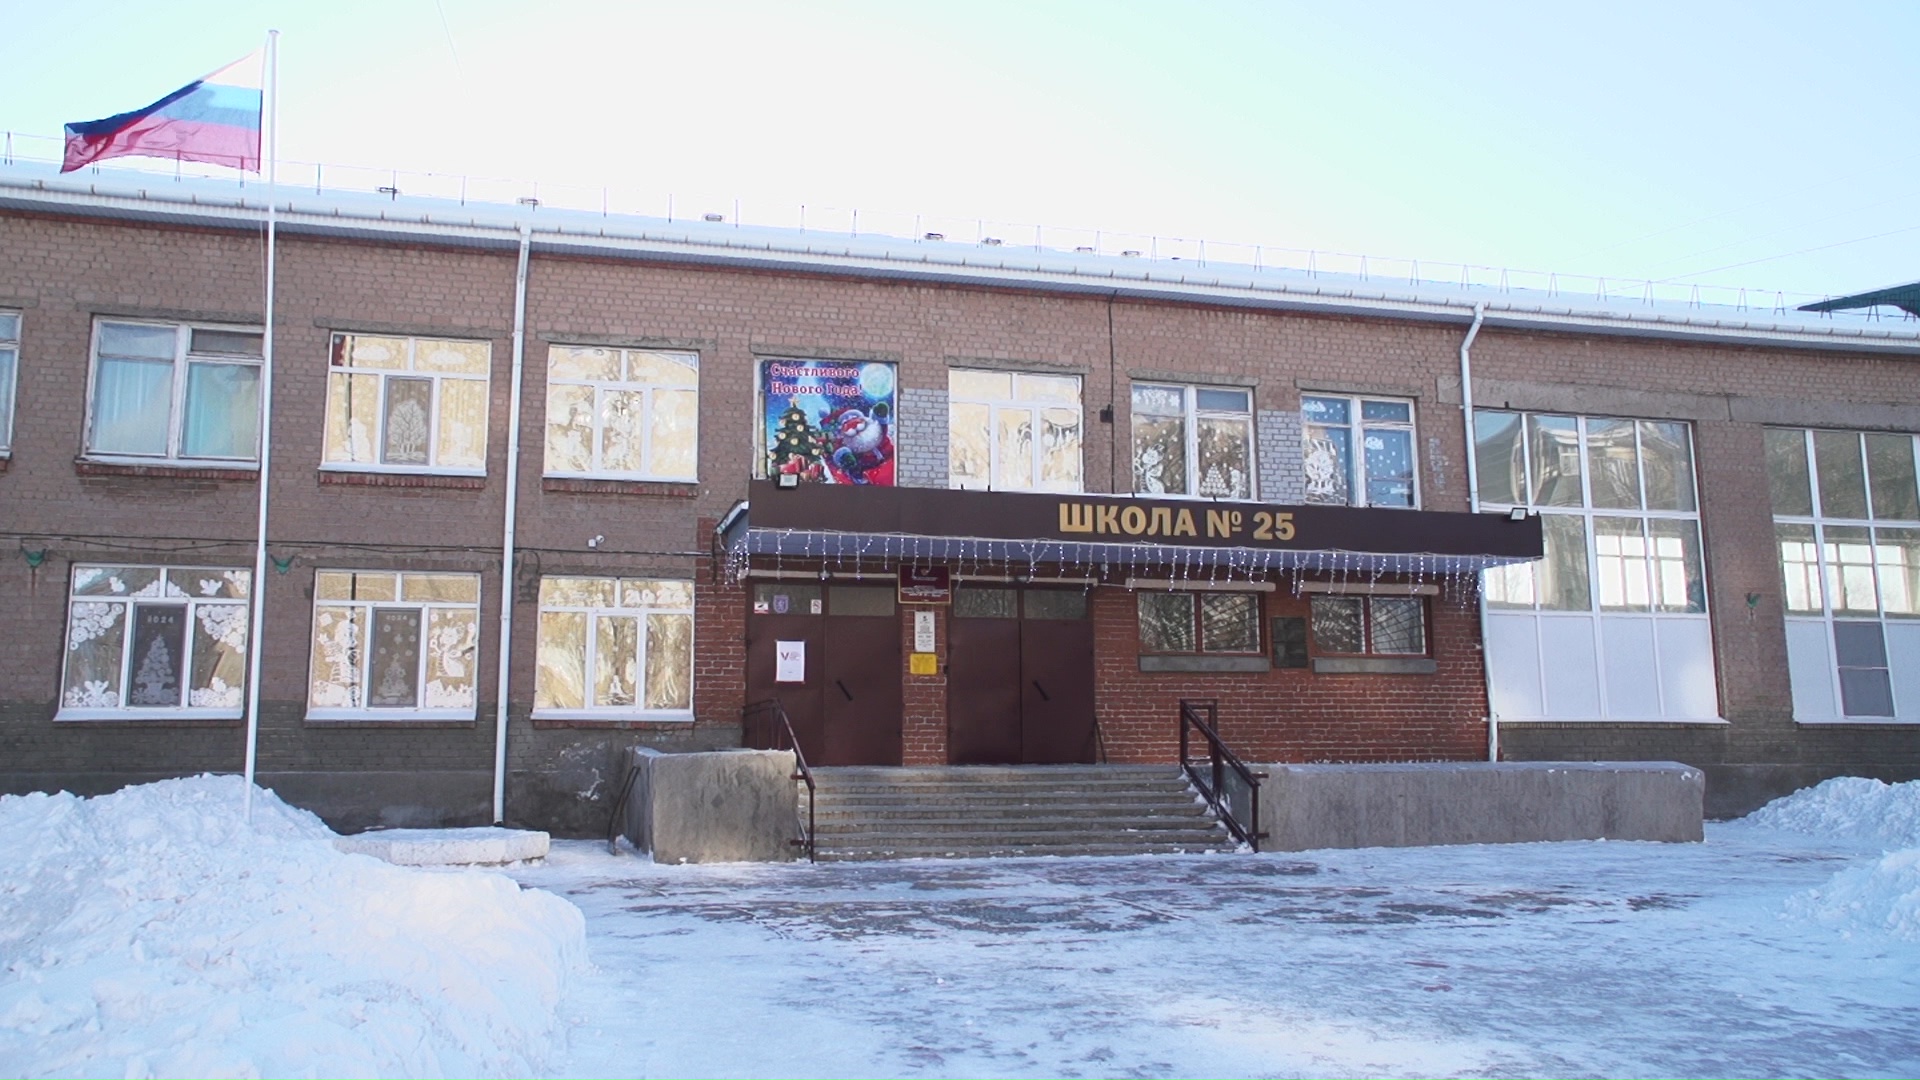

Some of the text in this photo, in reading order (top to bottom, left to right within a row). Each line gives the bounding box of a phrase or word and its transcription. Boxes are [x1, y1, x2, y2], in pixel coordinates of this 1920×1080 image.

[770, 363, 860, 378] Счастливого
[772, 382, 863, 397] Нового Года!
[1059, 503, 1296, 540] ШКОЛА № 25
